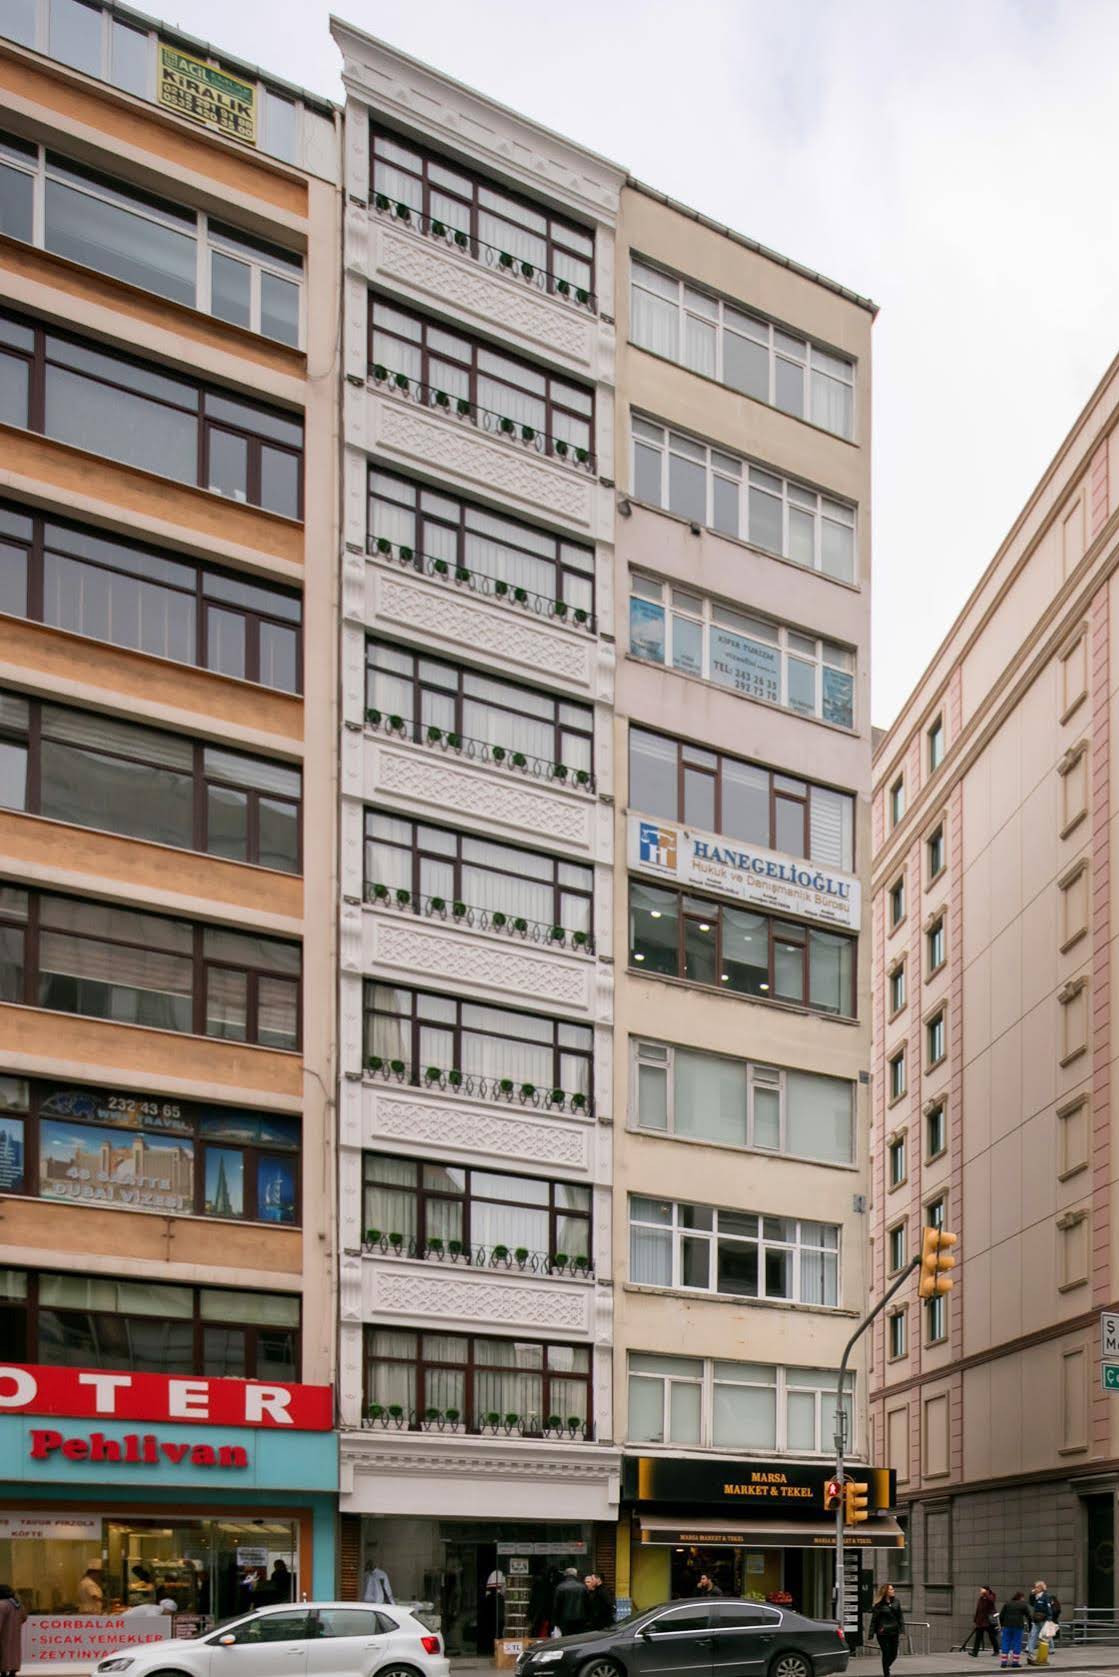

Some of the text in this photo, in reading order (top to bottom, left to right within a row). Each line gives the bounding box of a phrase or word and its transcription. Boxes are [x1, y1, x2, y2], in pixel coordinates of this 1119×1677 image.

[693, 840, 851, 898] HANEGELİOĞLU
[108, 1096, 137, 1112] 232
[141, 1103, 158, 1116] 43
[162, 1104, 181, 1118] 65
[29, 1428, 249, 1468] Pehlivan
[751, 1472, 787, 1483] MARSA
[723, 1484, 814, 1498] MARKET & TEKEL
